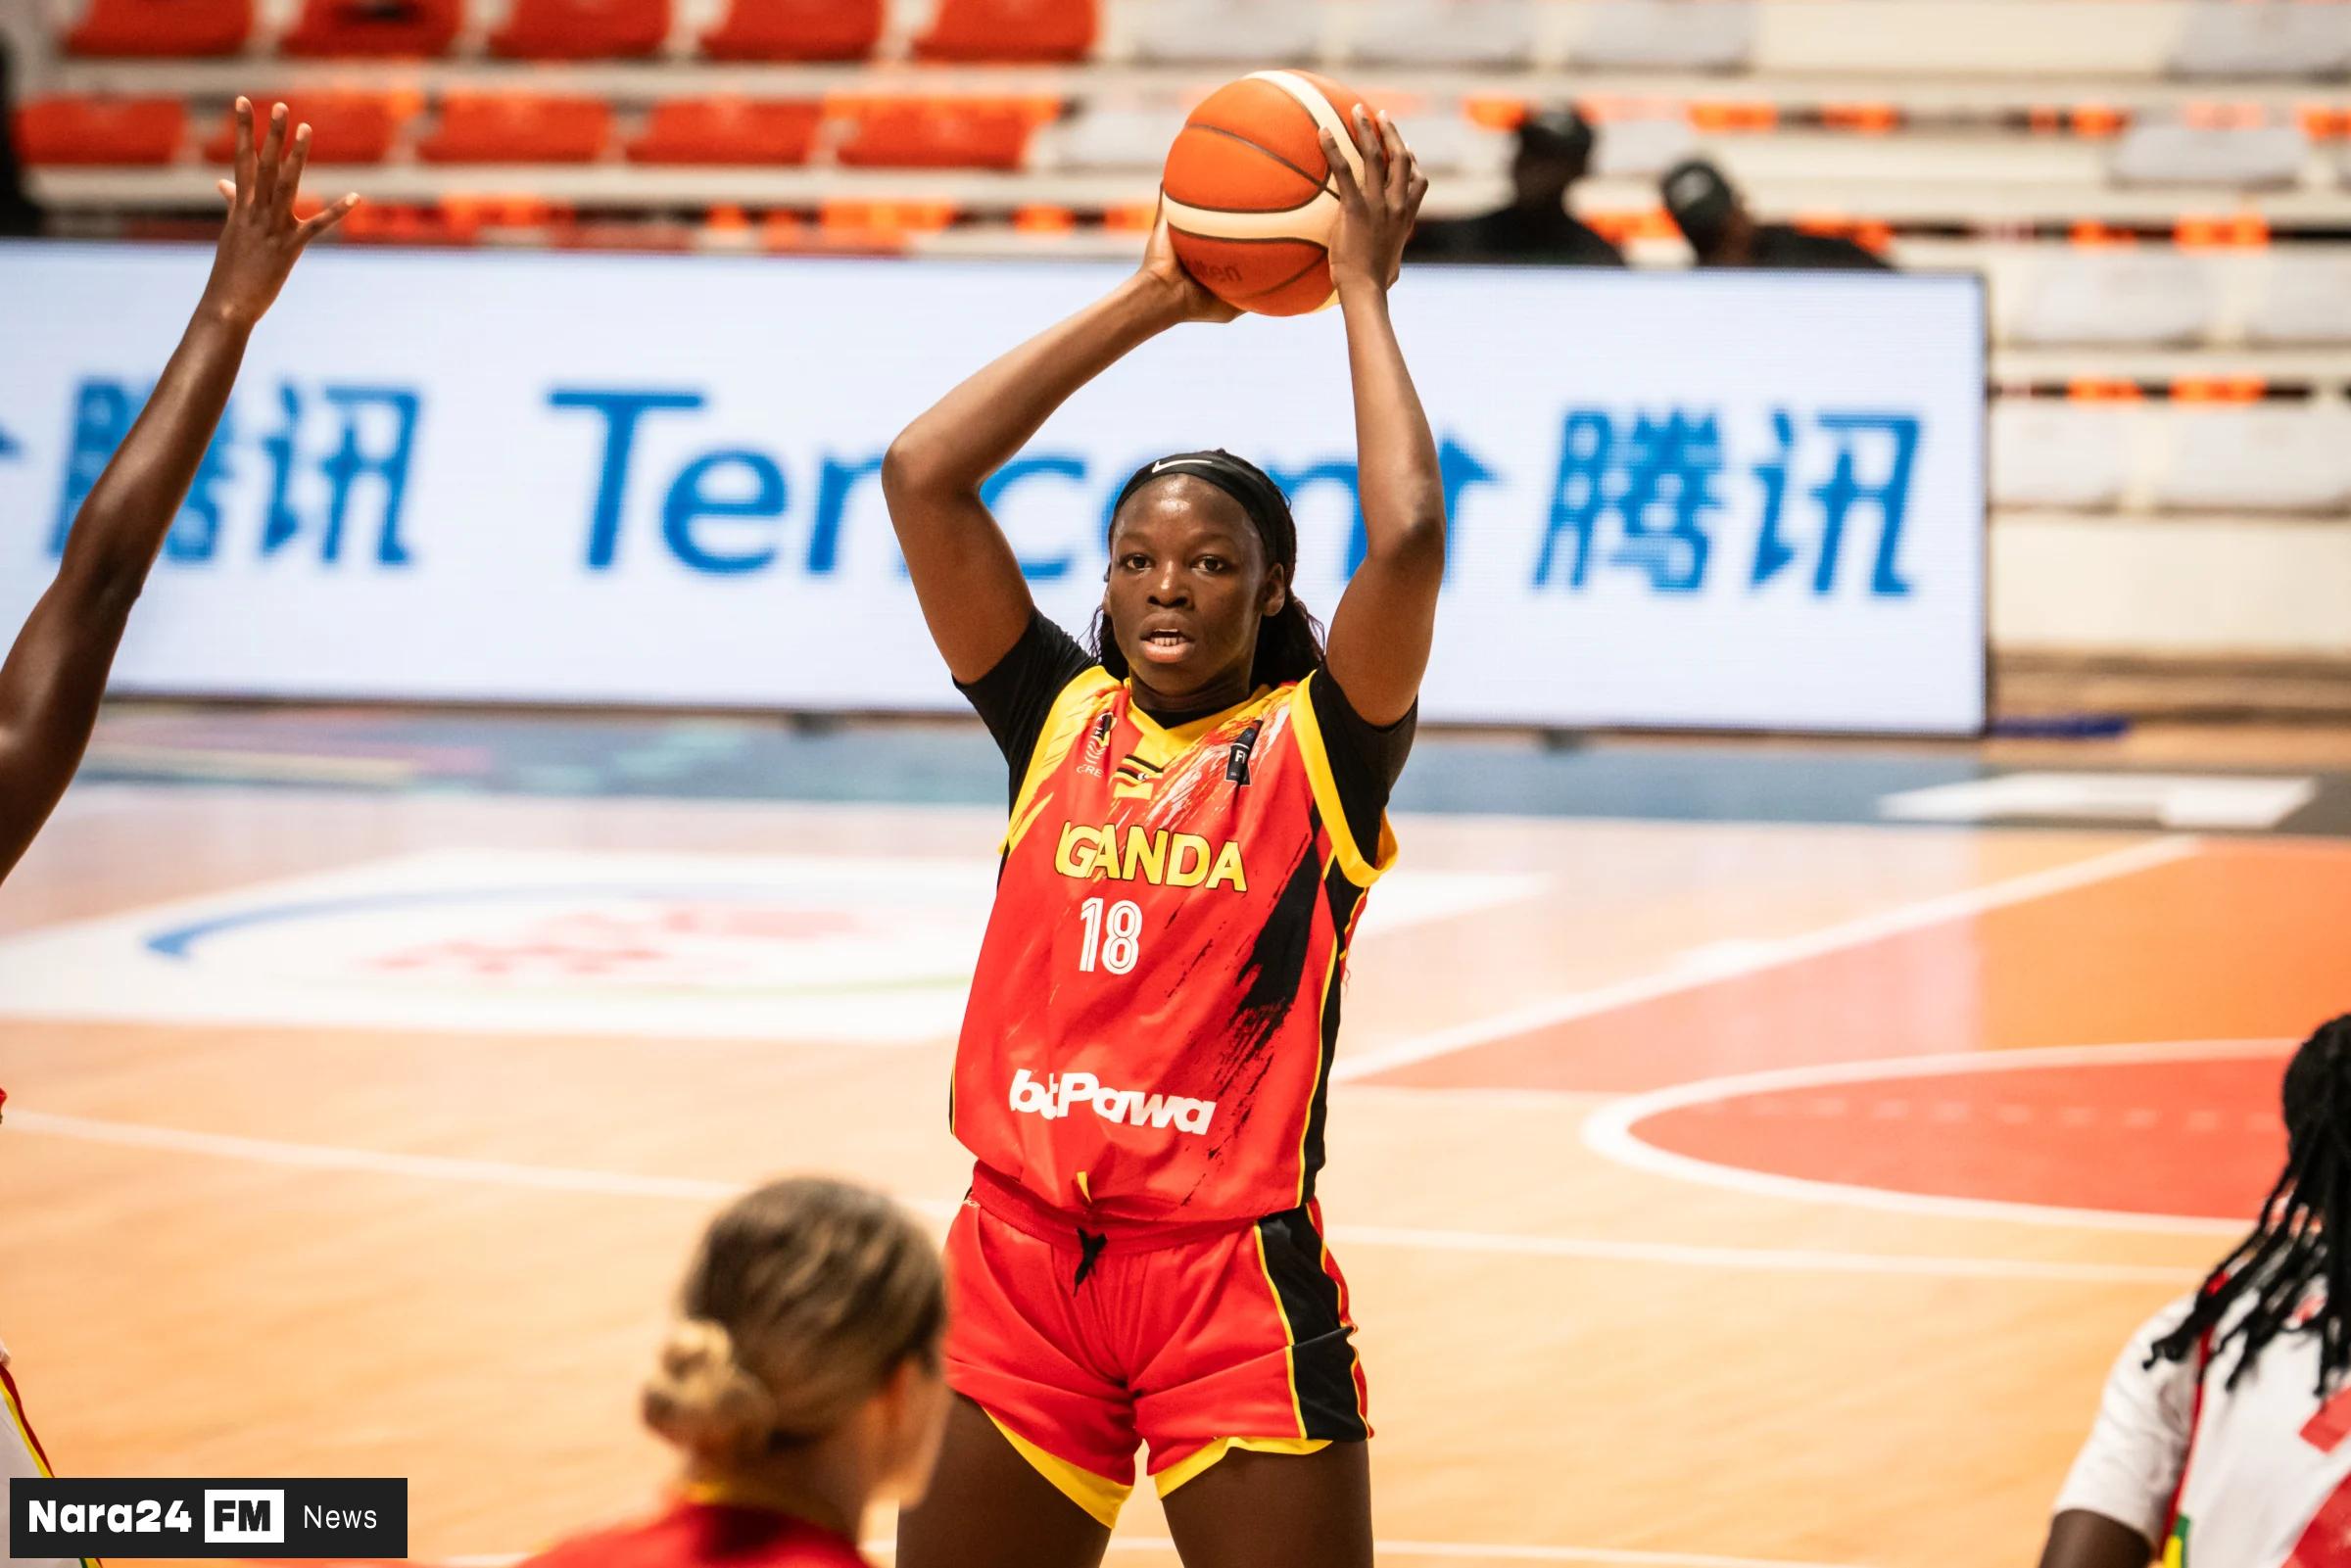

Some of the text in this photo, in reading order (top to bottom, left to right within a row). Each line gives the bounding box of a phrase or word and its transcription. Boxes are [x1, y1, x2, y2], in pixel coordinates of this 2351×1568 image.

[1533, 405, 1919, 597] 腾讯
[1079, 897, 1143, 974] 18
[1009, 1068, 1217, 1136] btPawa
